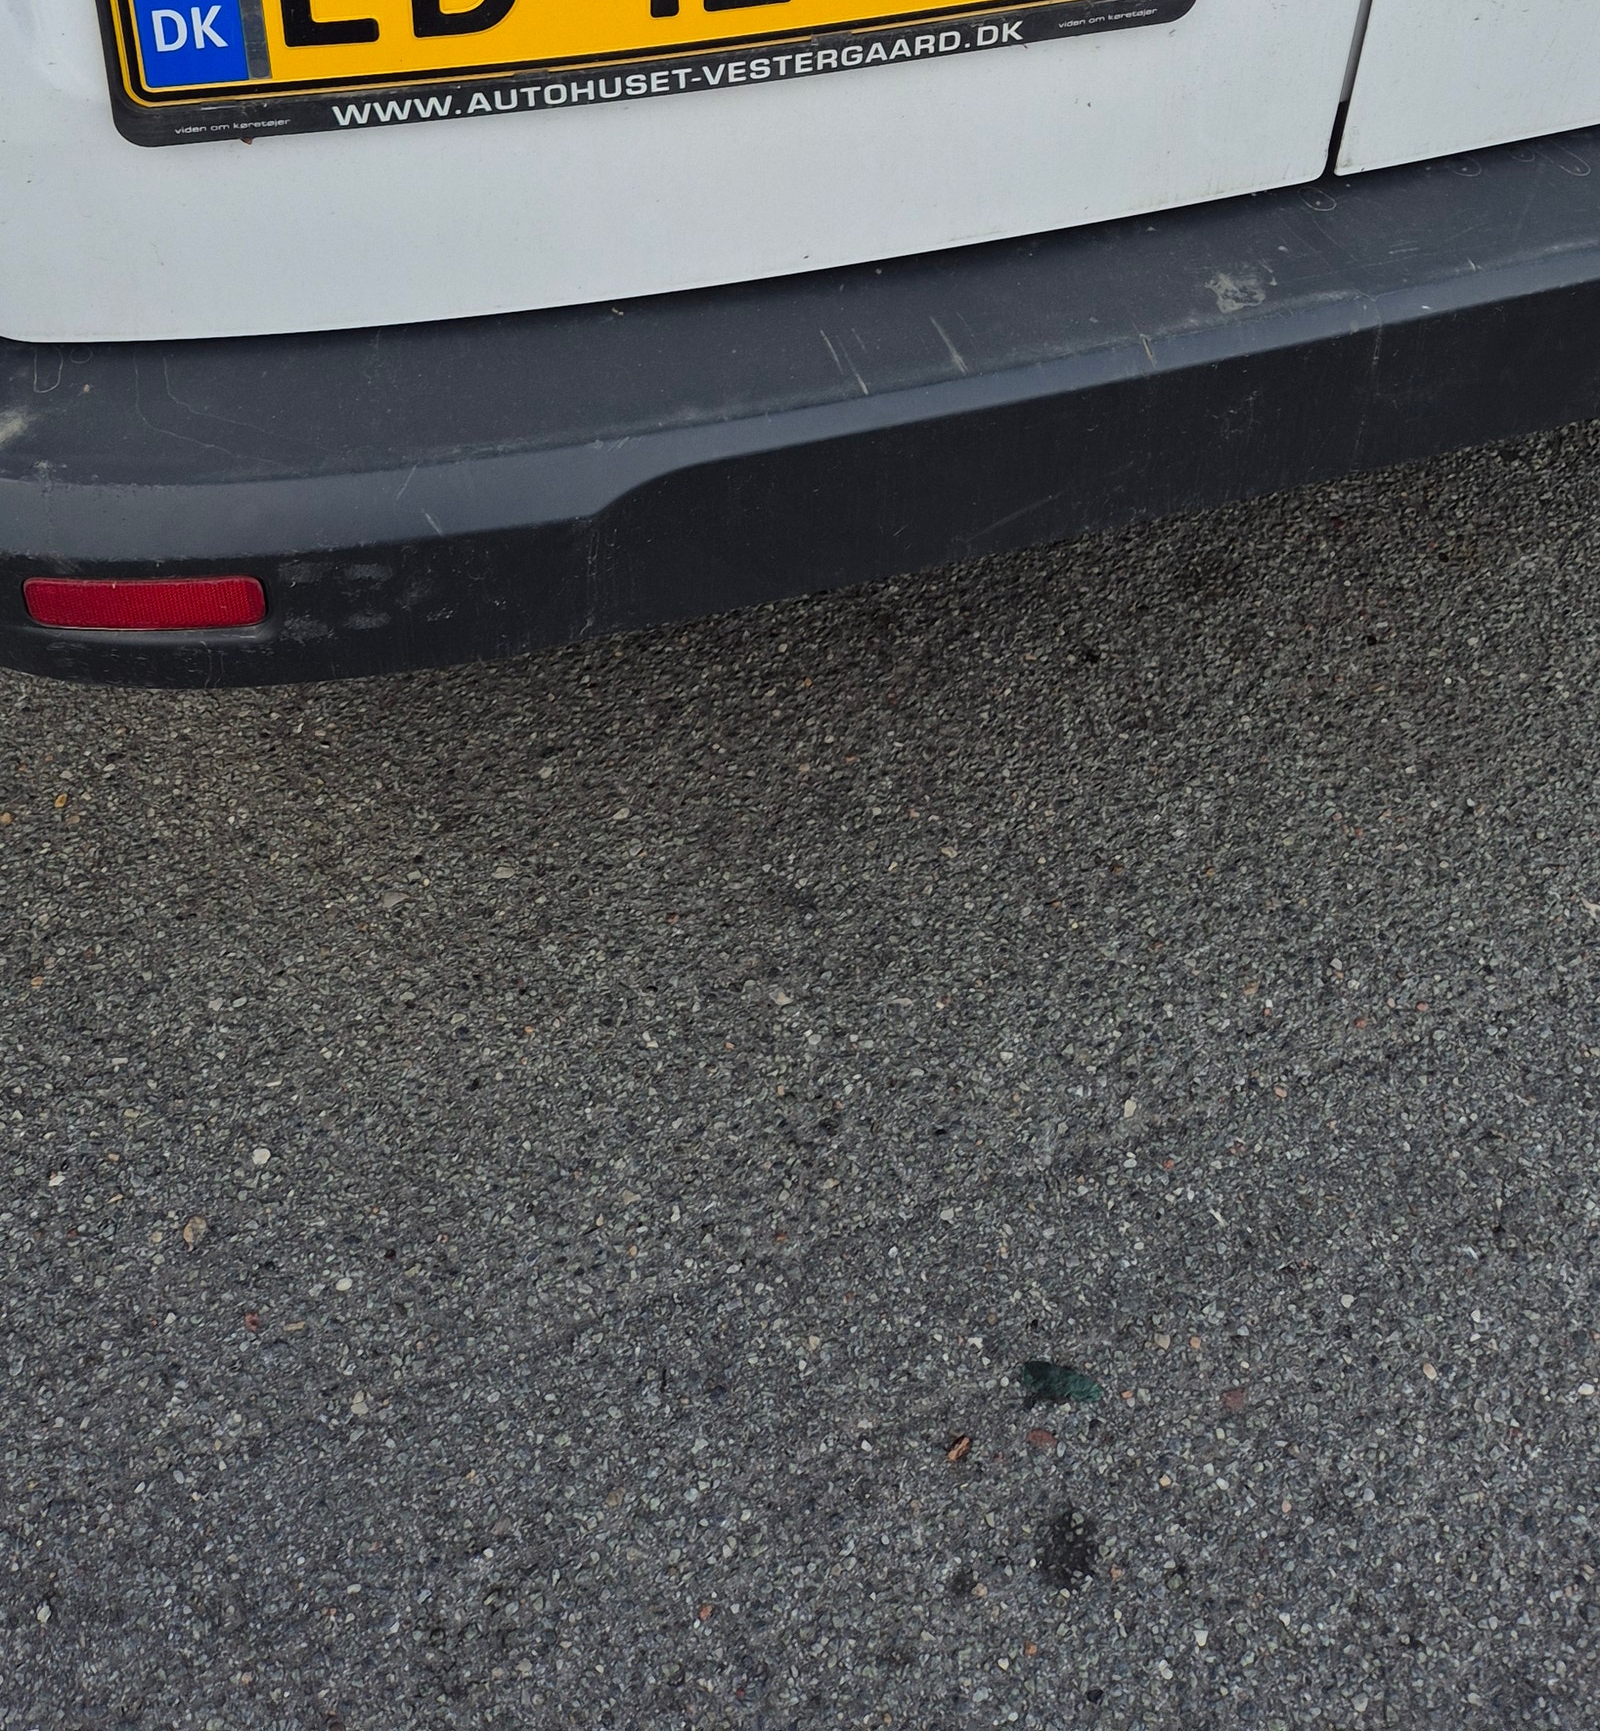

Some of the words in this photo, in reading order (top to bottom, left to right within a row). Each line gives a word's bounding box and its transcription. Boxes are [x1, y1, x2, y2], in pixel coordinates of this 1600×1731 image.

[150, 4, 229, 53] DK
[1058, 18, 1086, 28] viden
[1088, 15, 1106, 24] om
[331, 20, 1024, 127] WWW.AUTOHUSET-VESTERGAARD.DK
[174, 125, 207, 135] viden
[210, 123, 230, 132] om
